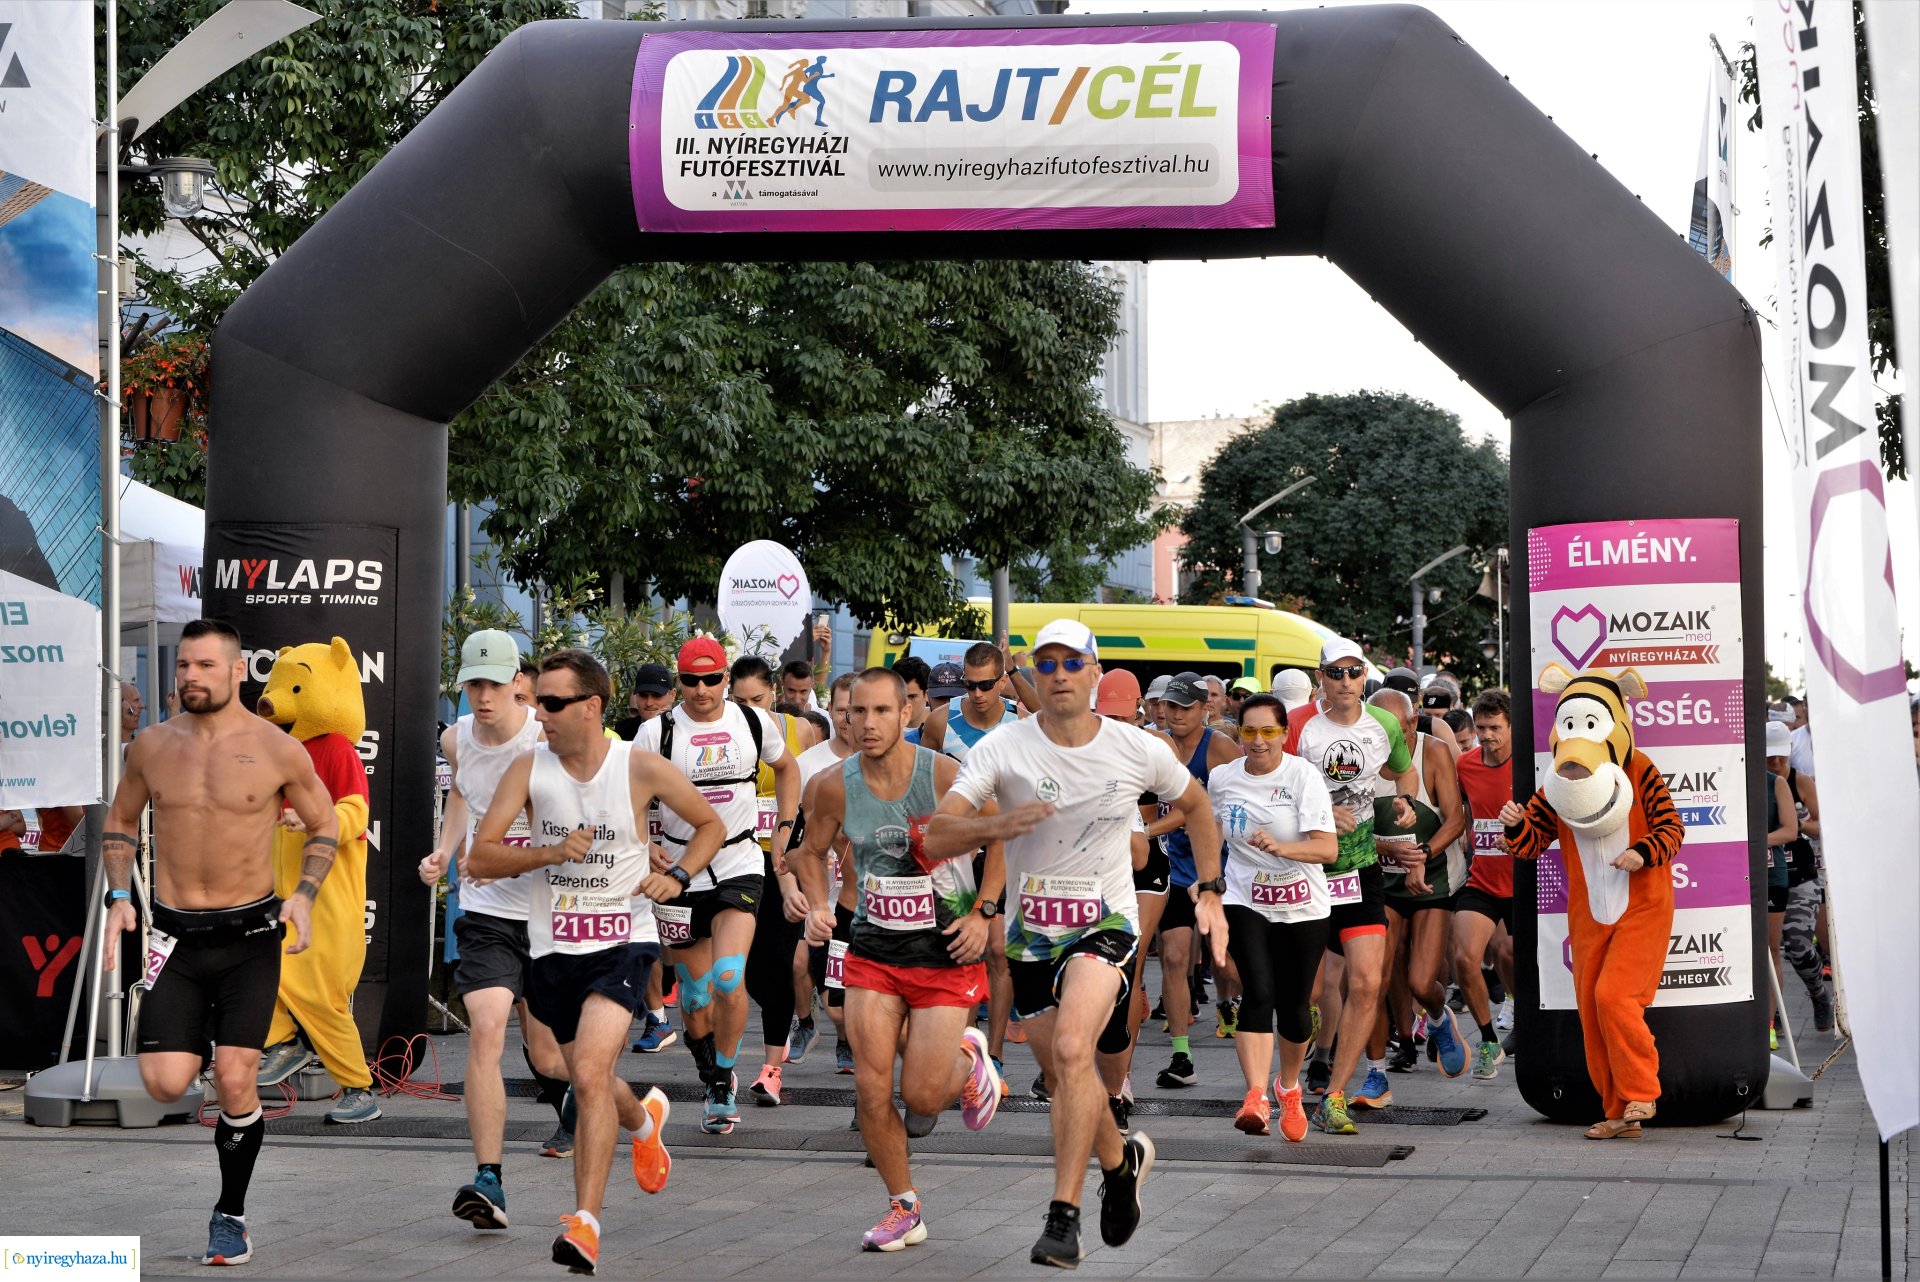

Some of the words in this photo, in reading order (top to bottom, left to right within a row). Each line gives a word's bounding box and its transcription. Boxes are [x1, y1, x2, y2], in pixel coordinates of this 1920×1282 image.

[869, 51, 1219, 126] RAJT/CÉL
[675, 137, 700, 155] III.
[707, 132, 849, 155] NYÍREGYHÁZI
[680, 155, 846, 178] FUTÓFESZTIVÁL
[878, 154, 1210, 182] www.nyiregyhazifutofesztival.hu
[711, 190, 717, 198] a
[758, 189, 819, 201] támogatásával
[1568, 531, 1697, 568] ÉLMÉNY.
[215, 558, 383, 591] MYLAPS
[245, 594, 312, 605] SPORTS
[319, 594, 379, 606] TIMING
[1609, 610, 1711, 634] MOZAIK
[1685, 631, 1712, 642] med
[480, 648, 489, 658] R
[1609, 648, 1698, 664] NYÍREGYHÁZA
[1662, 771, 1718, 793] ZAIK
[1692, 792, 1719, 804] med
[541, 819, 569, 838] Kiss
[1253, 882, 1309, 902] 21219
[866, 893, 932, 918] 21004
[1022, 897, 1098, 924] 21119
[554, 915, 630, 938] 21150
[657, 921, 690, 940] 036
[1667, 932, 1724, 955] ZAIK
[1699, 953, 1724, 966] med
[1659, 972, 1711, 986] JI-HEGY
